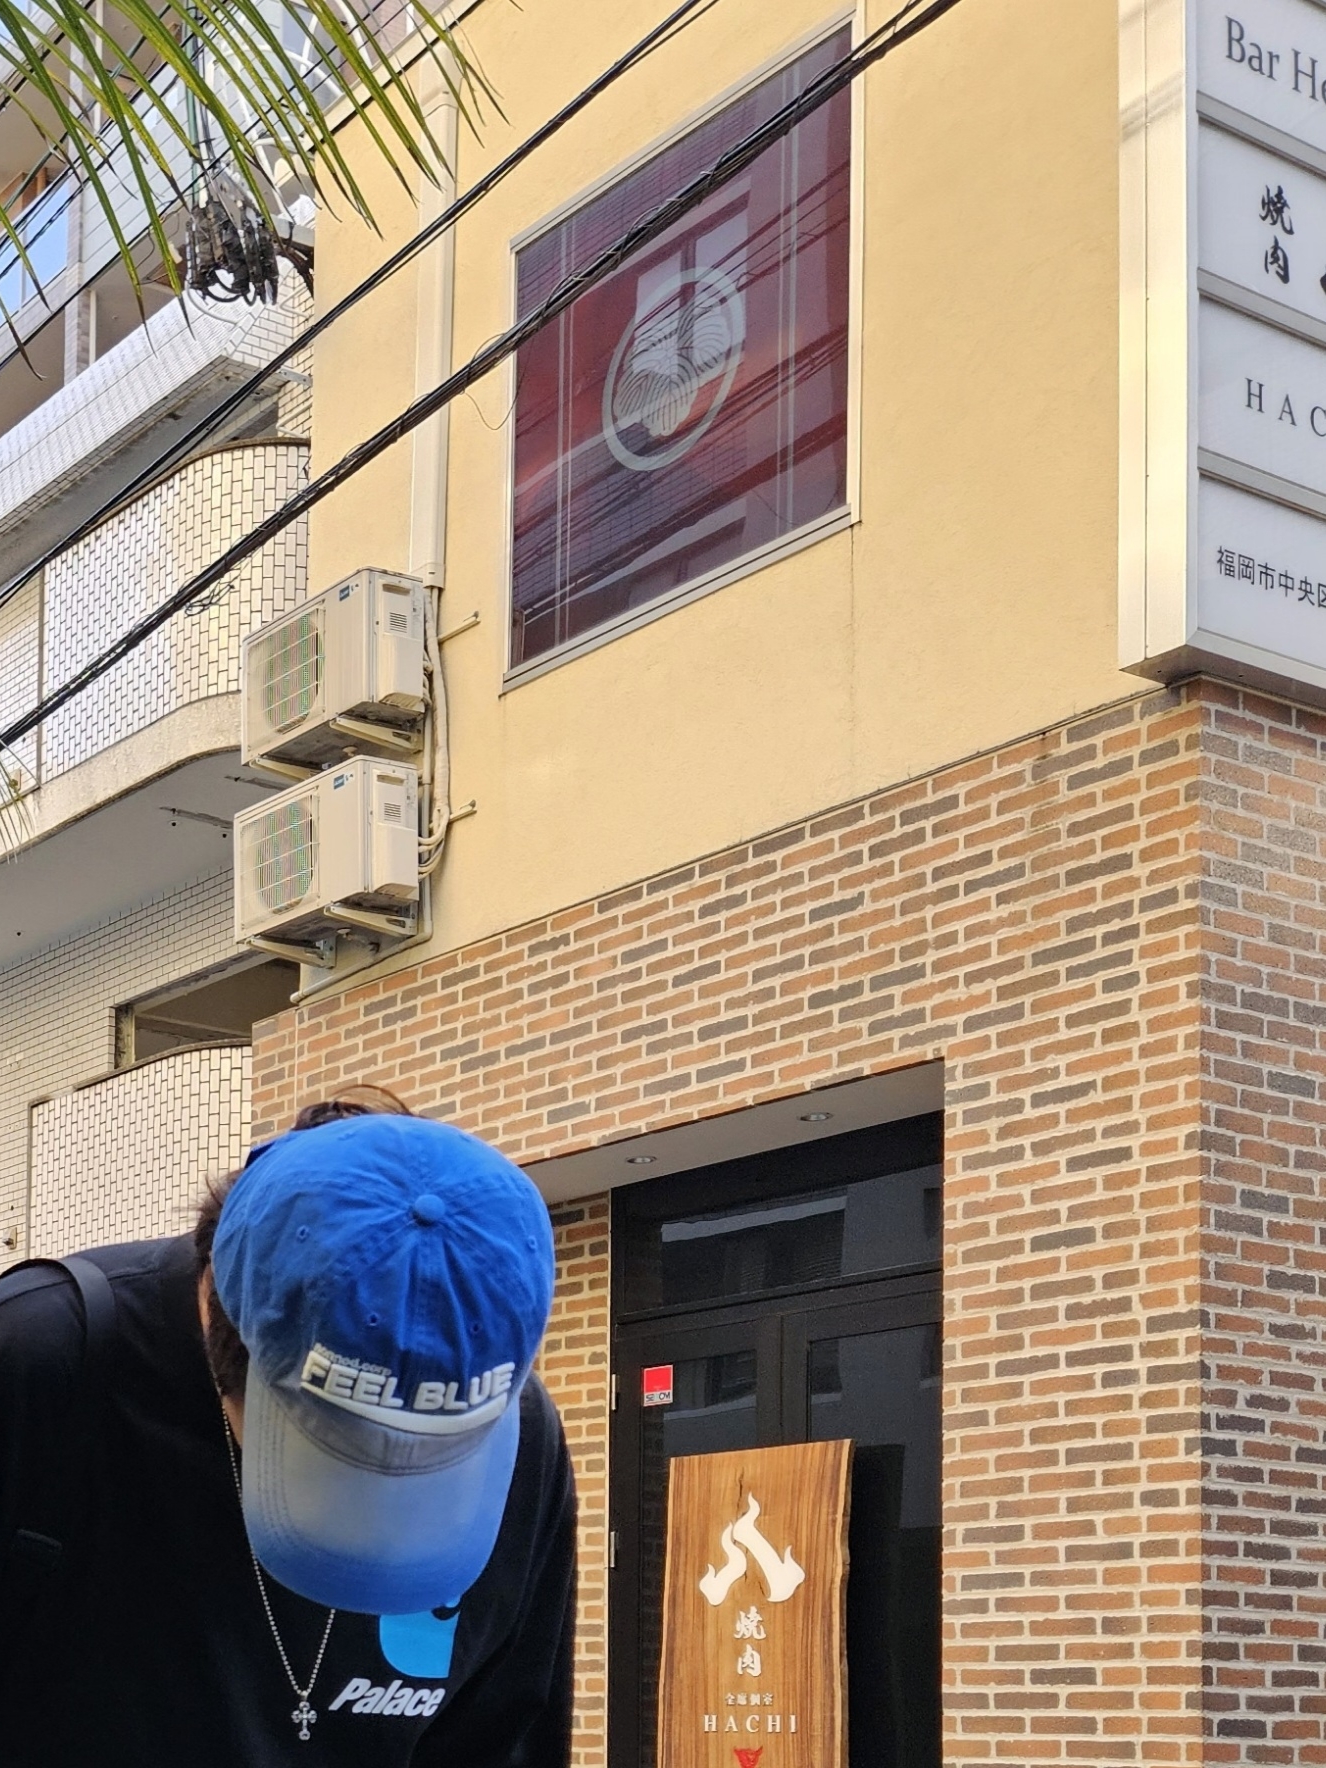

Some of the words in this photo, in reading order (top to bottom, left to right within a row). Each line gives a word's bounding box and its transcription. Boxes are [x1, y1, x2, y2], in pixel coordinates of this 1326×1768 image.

[1225, 15, 1280, 81] Bar
[1259, 185, 1295, 284] 焼肉
[301, 1350, 404, 1408] FEEL
[413, 1362, 515, 1410] BLUE
[734, 1605, 767, 1677] 焼肉
[328, 1677, 446, 1717] Palace
[703, 1714, 798, 1733] HACHI
